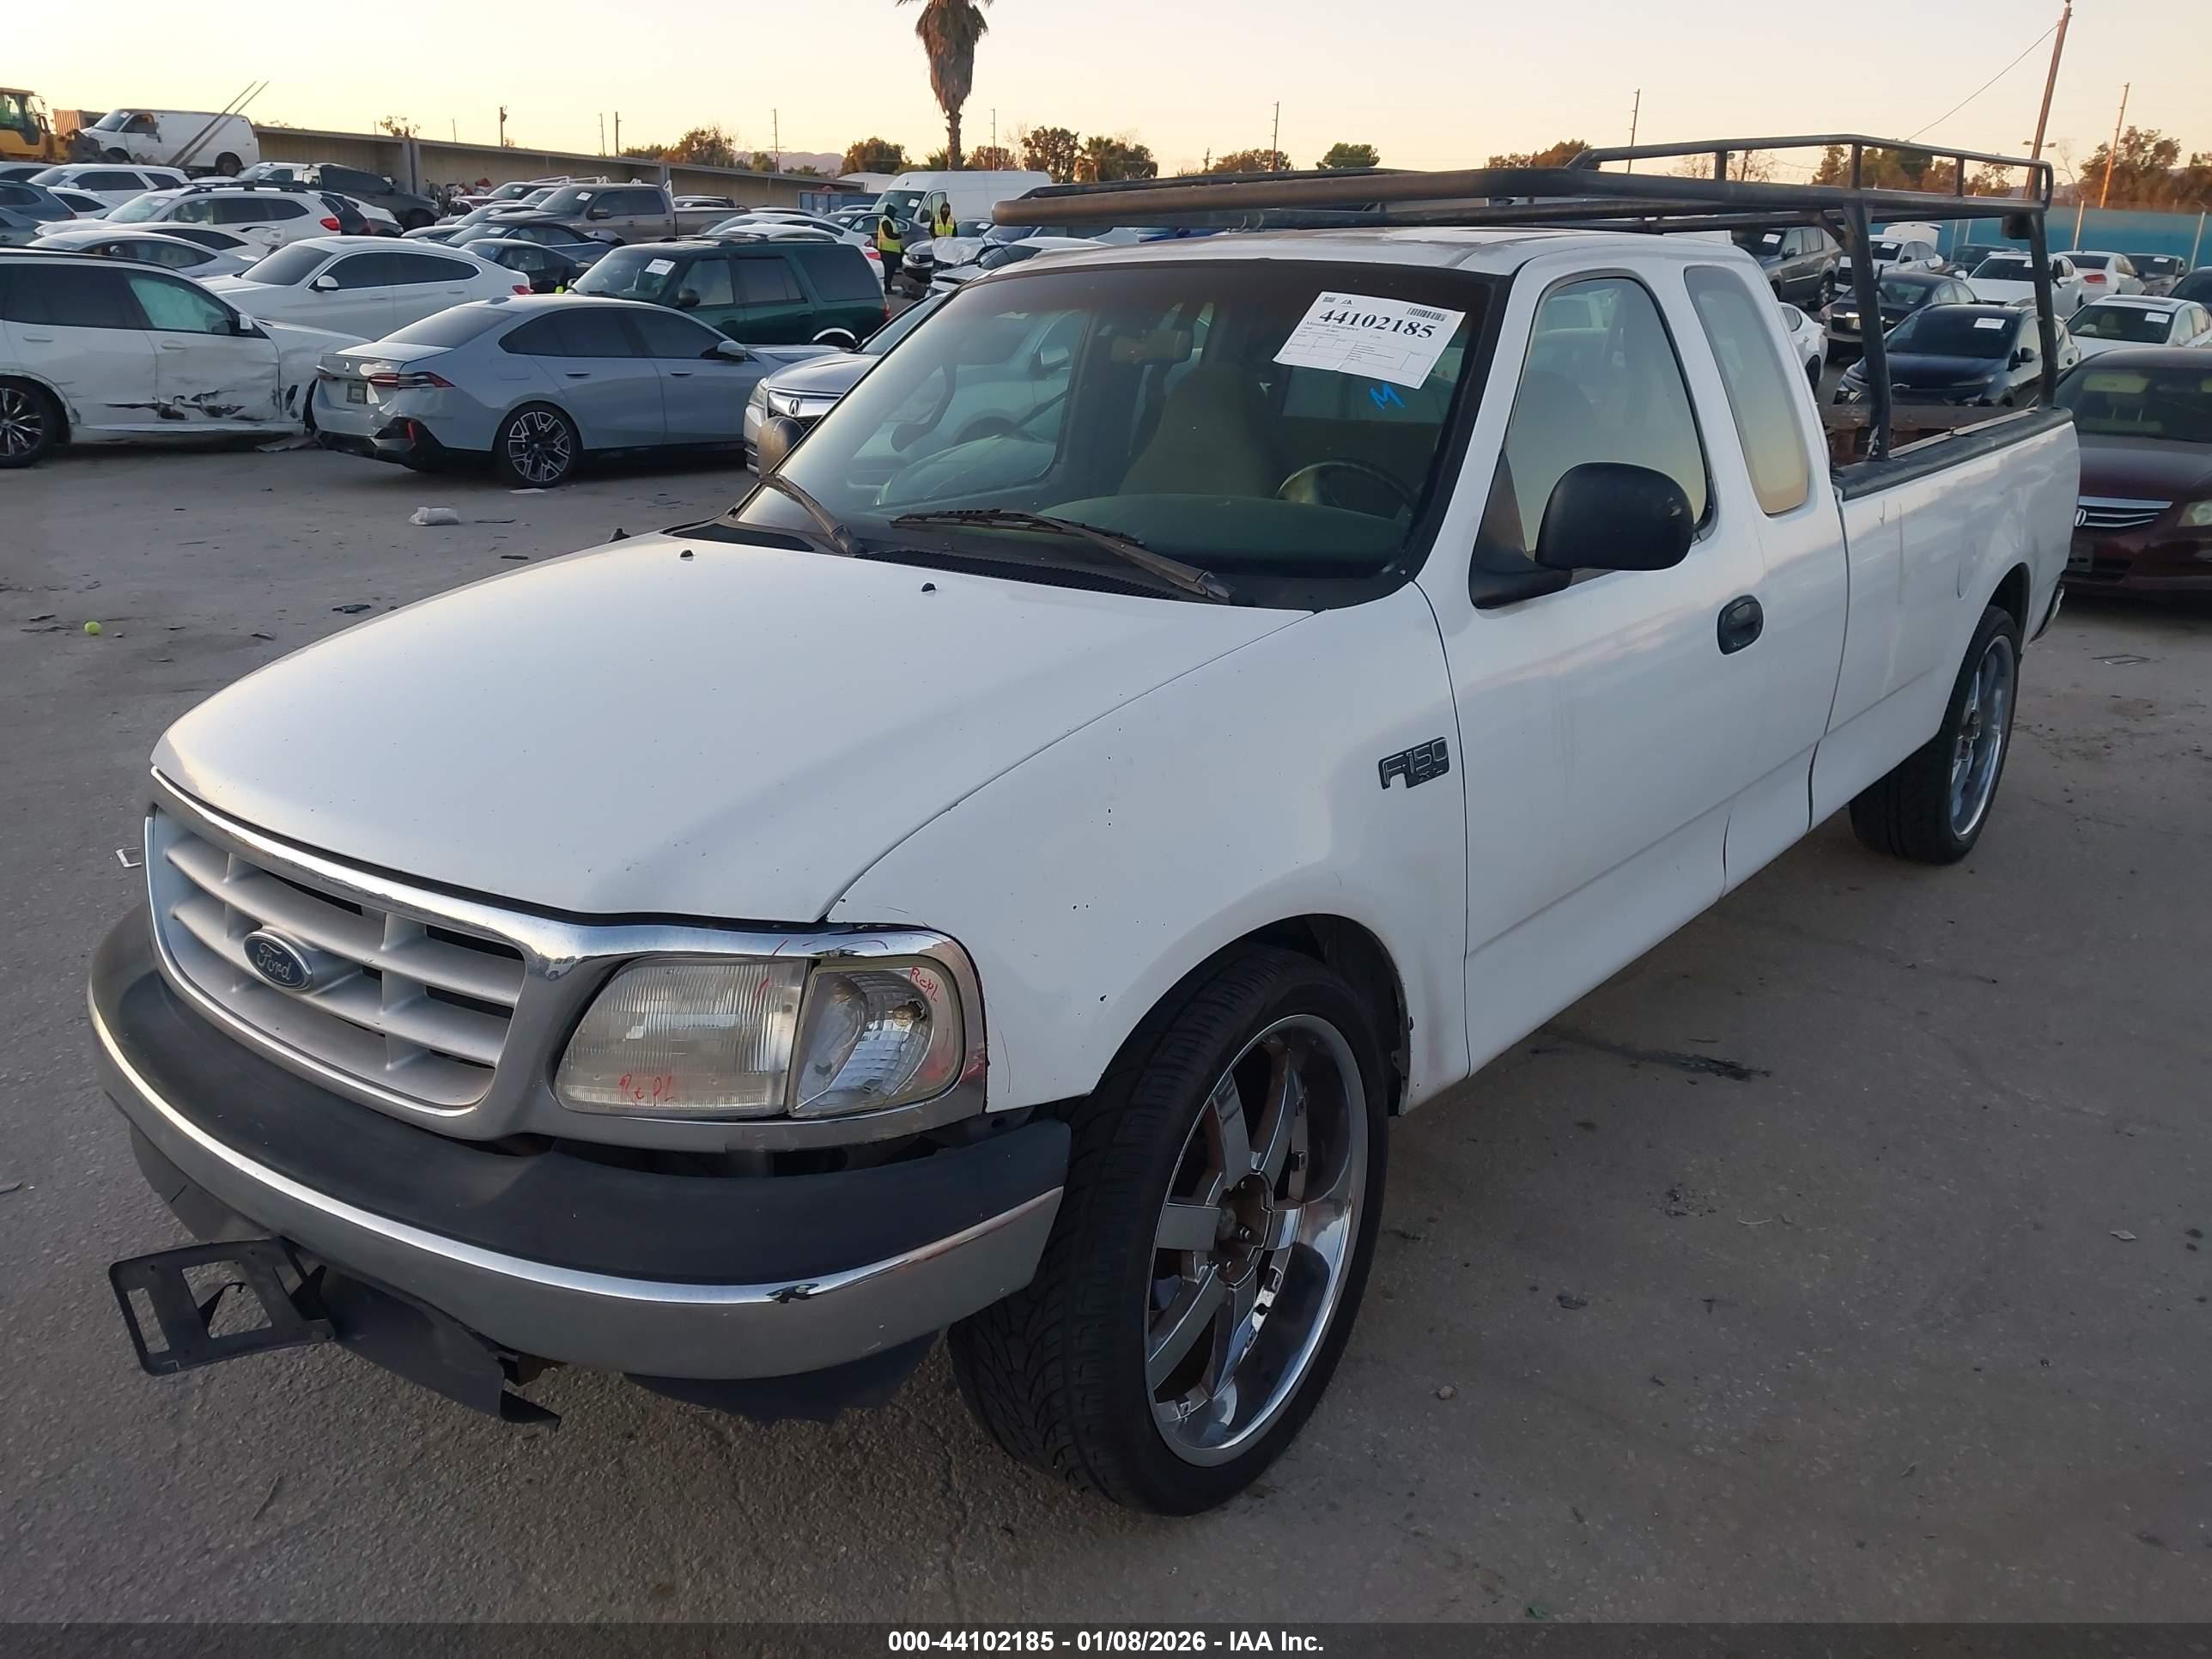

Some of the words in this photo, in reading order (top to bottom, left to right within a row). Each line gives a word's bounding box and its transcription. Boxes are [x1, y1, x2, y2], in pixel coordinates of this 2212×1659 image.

[1319, 309, 1437, 338] 44102185
[1369, 384, 1405, 410] M
[256, 942, 292, 981] Ford
